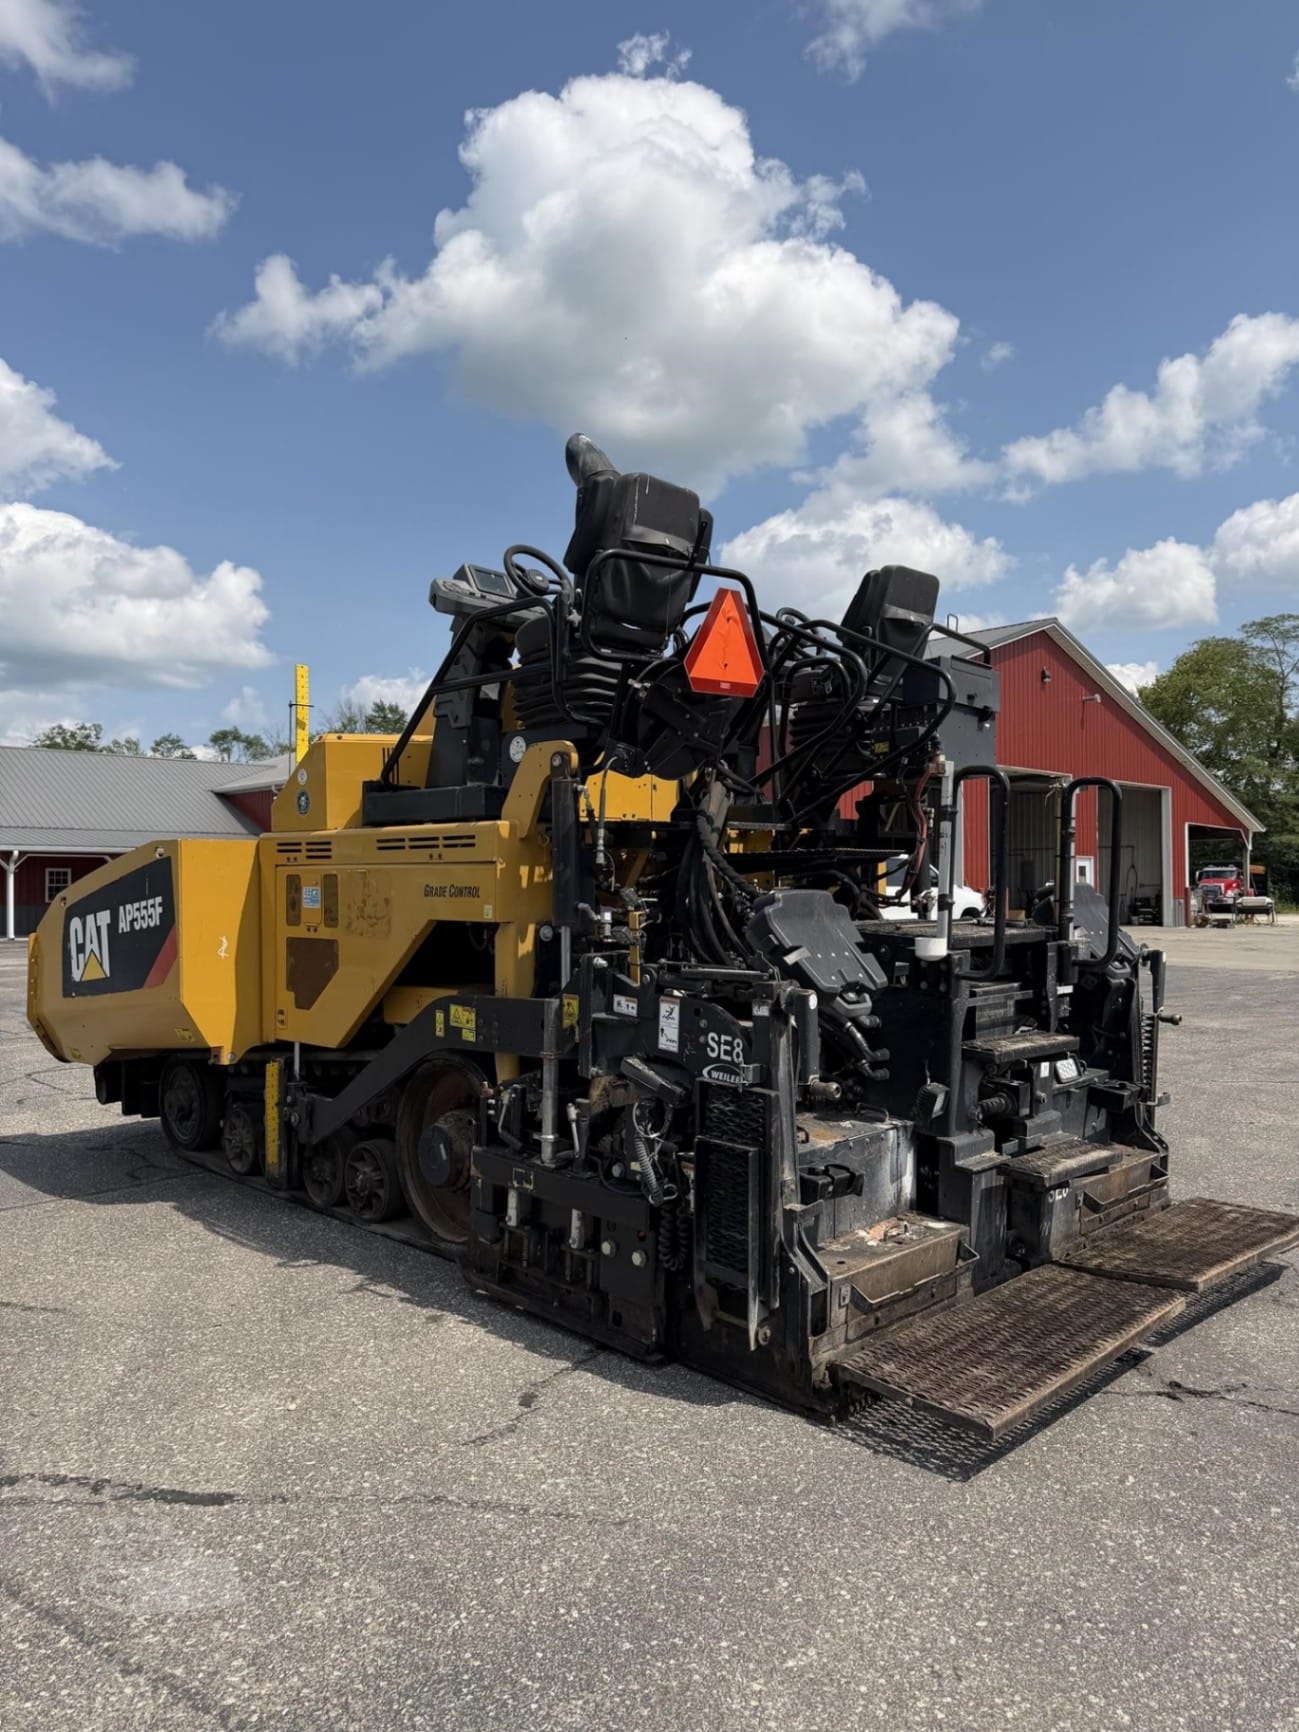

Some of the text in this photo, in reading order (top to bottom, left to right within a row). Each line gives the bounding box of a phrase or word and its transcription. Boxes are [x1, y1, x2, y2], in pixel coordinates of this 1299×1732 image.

[449, 884, 480, 898] CONTROL
[118, 896, 163, 934] AP555F
[70, 909, 111, 982] CAT
[706, 1031, 743, 1064] SE8
